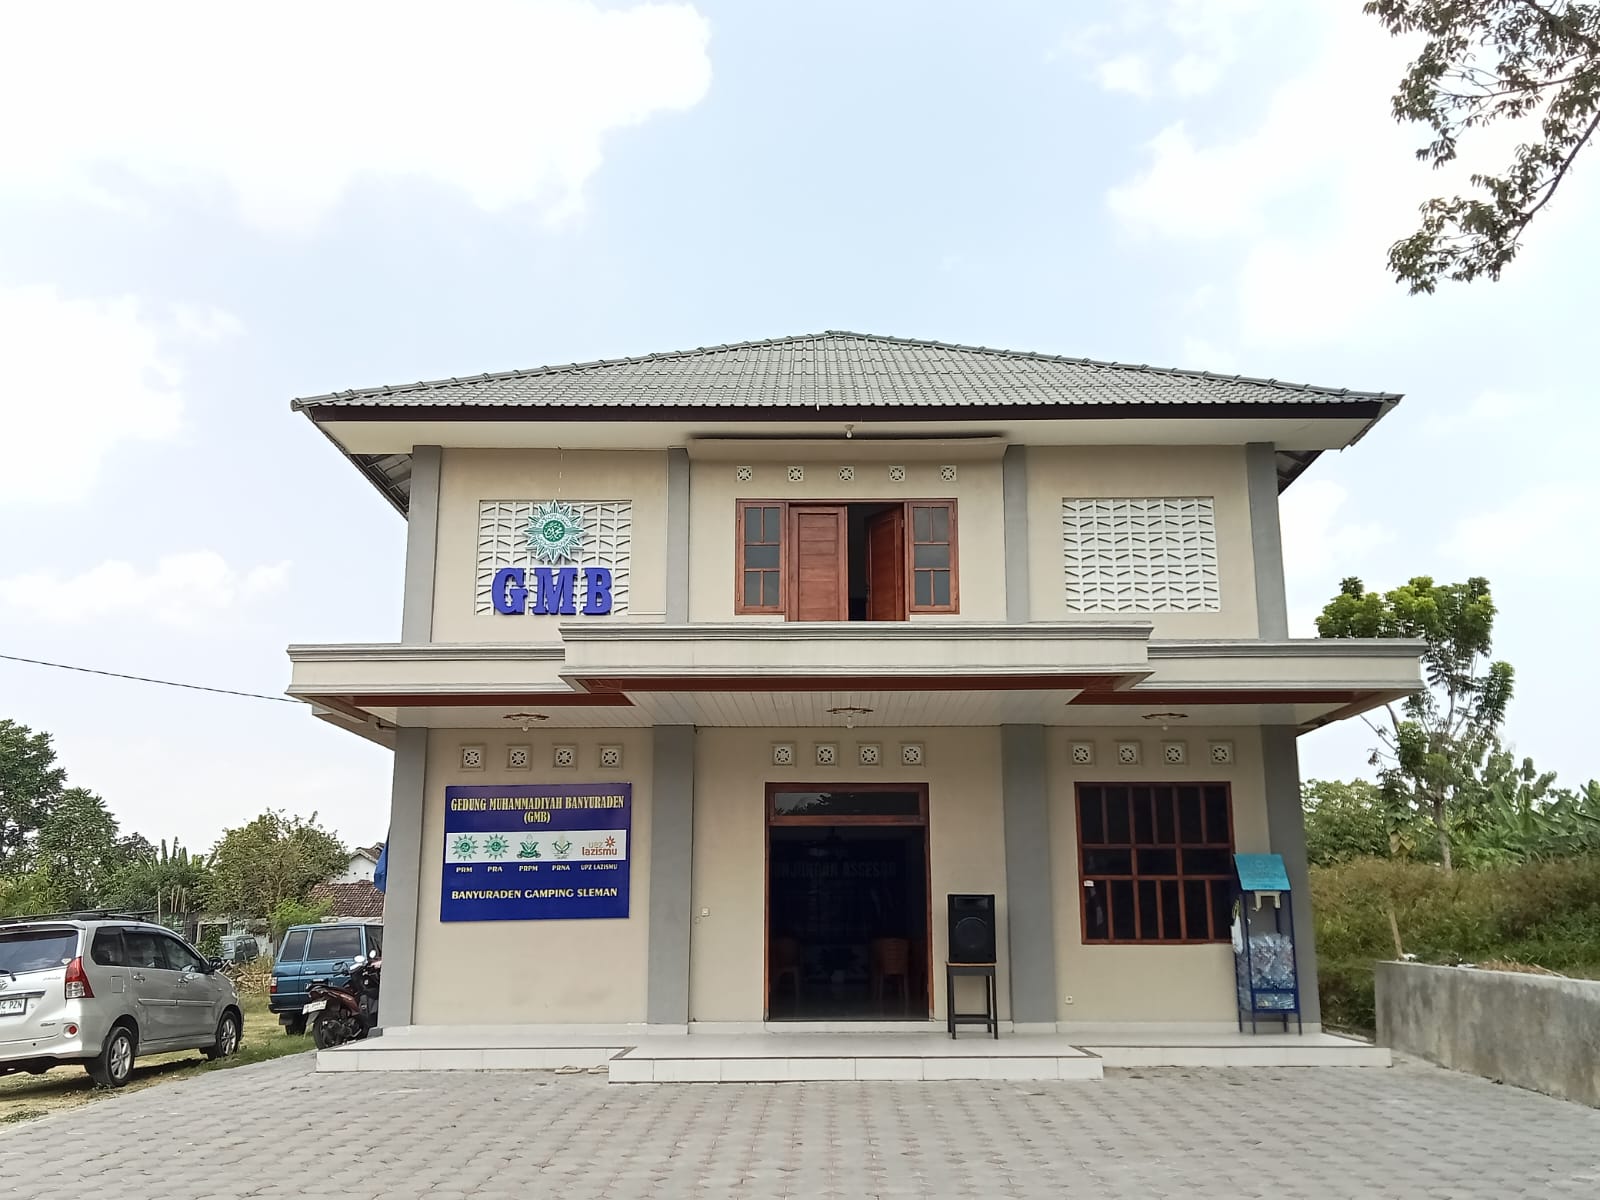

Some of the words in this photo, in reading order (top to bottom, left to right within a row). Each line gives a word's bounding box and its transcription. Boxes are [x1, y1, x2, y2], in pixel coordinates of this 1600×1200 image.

[492, 567, 613, 615] GMB
[451, 798, 487, 811] GEDUNG
[489, 796, 563, 811] MUHAMMADIYAH
[565, 795, 625, 809] BANYURADEN
[523, 811, 551, 825] (GMB)
[582, 846, 618, 856] lazismu
[451, 889, 522, 900] BANYURADEN
[524, 888, 575, 899] GAMPING
[576, 887, 618, 897] SLEMAN
